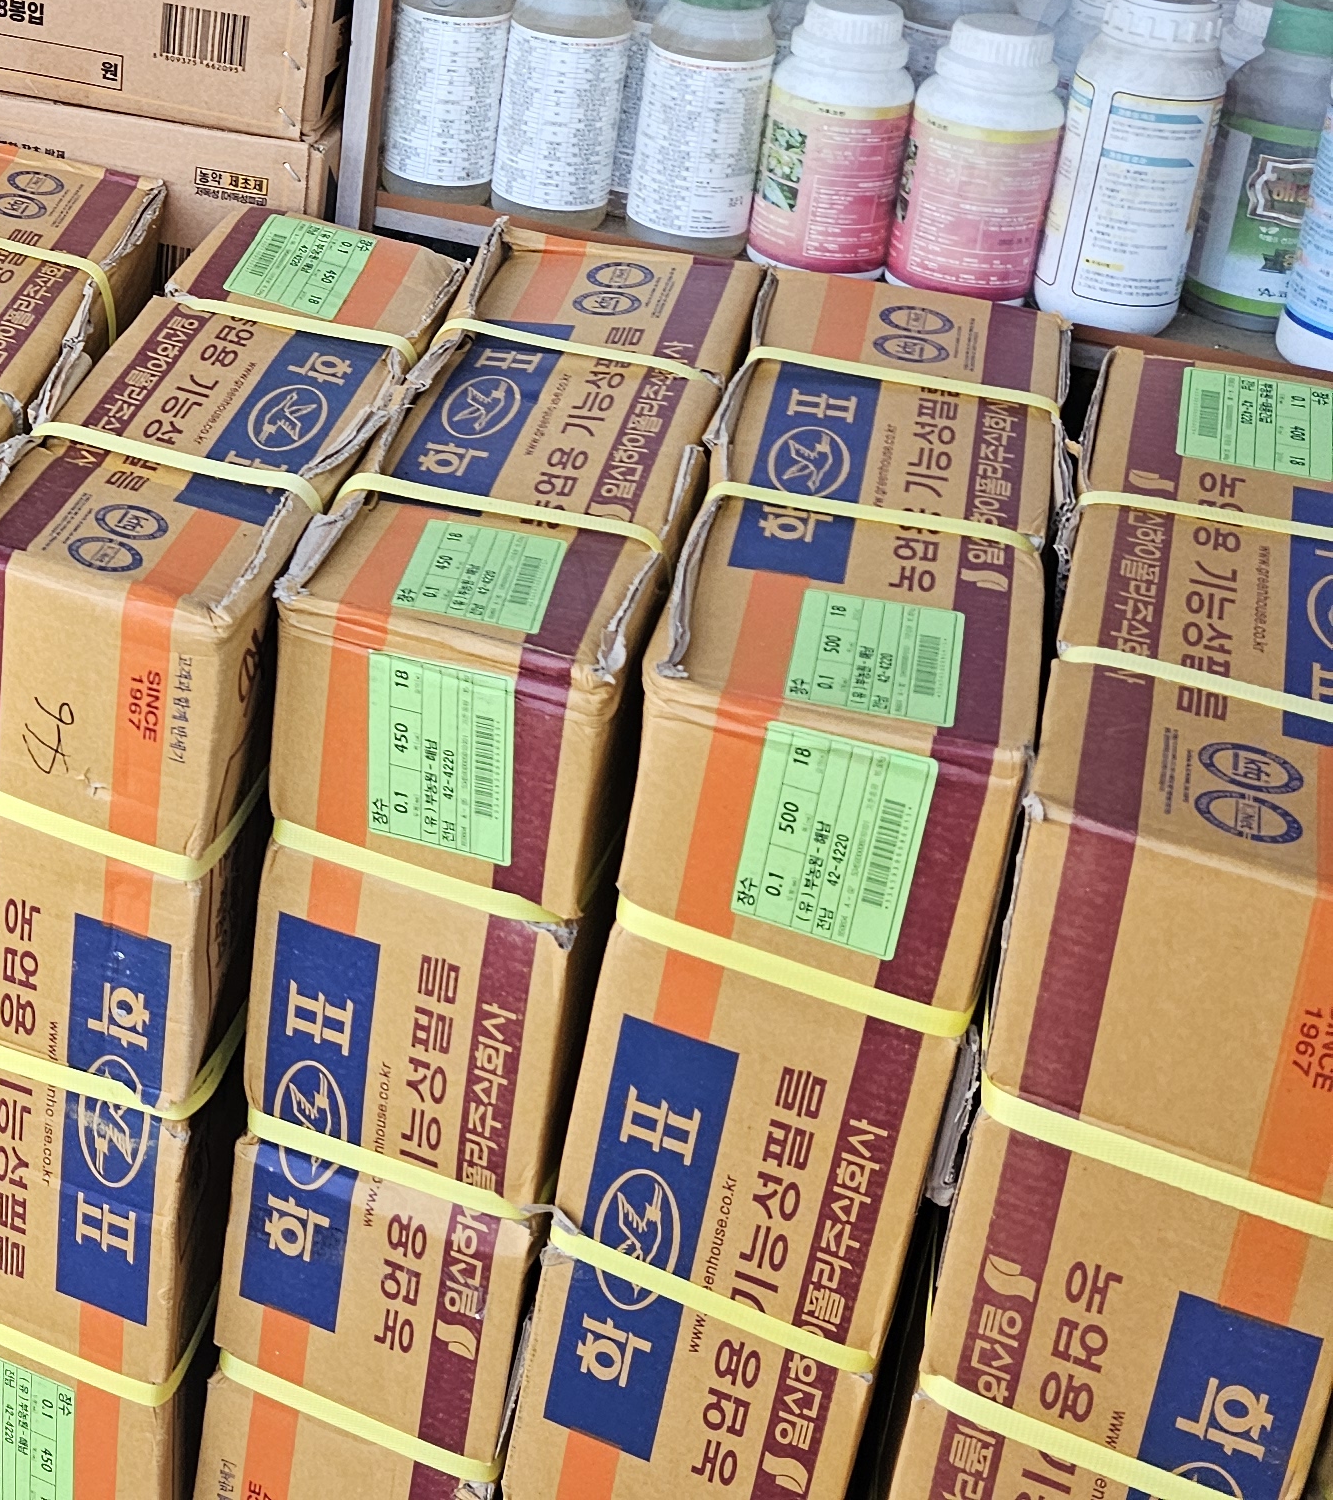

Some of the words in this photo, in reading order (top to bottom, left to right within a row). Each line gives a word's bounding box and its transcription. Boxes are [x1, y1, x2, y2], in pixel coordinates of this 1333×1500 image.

[765, 872, 785, 897] 0.1
[778, 801, 799, 834] 500
[793, 747, 812, 766] 18
[737, 877, 758, 906] 장수
[817, 907, 834, 931] 전남
[827, 833, 850, 887] 42-4220
[1, 898, 43, 1038] 농업용
[285, 980, 354, 1056] 표
[619, 1085, 703, 1166] 표
[264, 1195, 330, 1263] 학
[373, 1211, 428, 1355] 농업용
[577, 1314, 653, 1388] 학
[690, 1339, 762, 1486] 농업용
